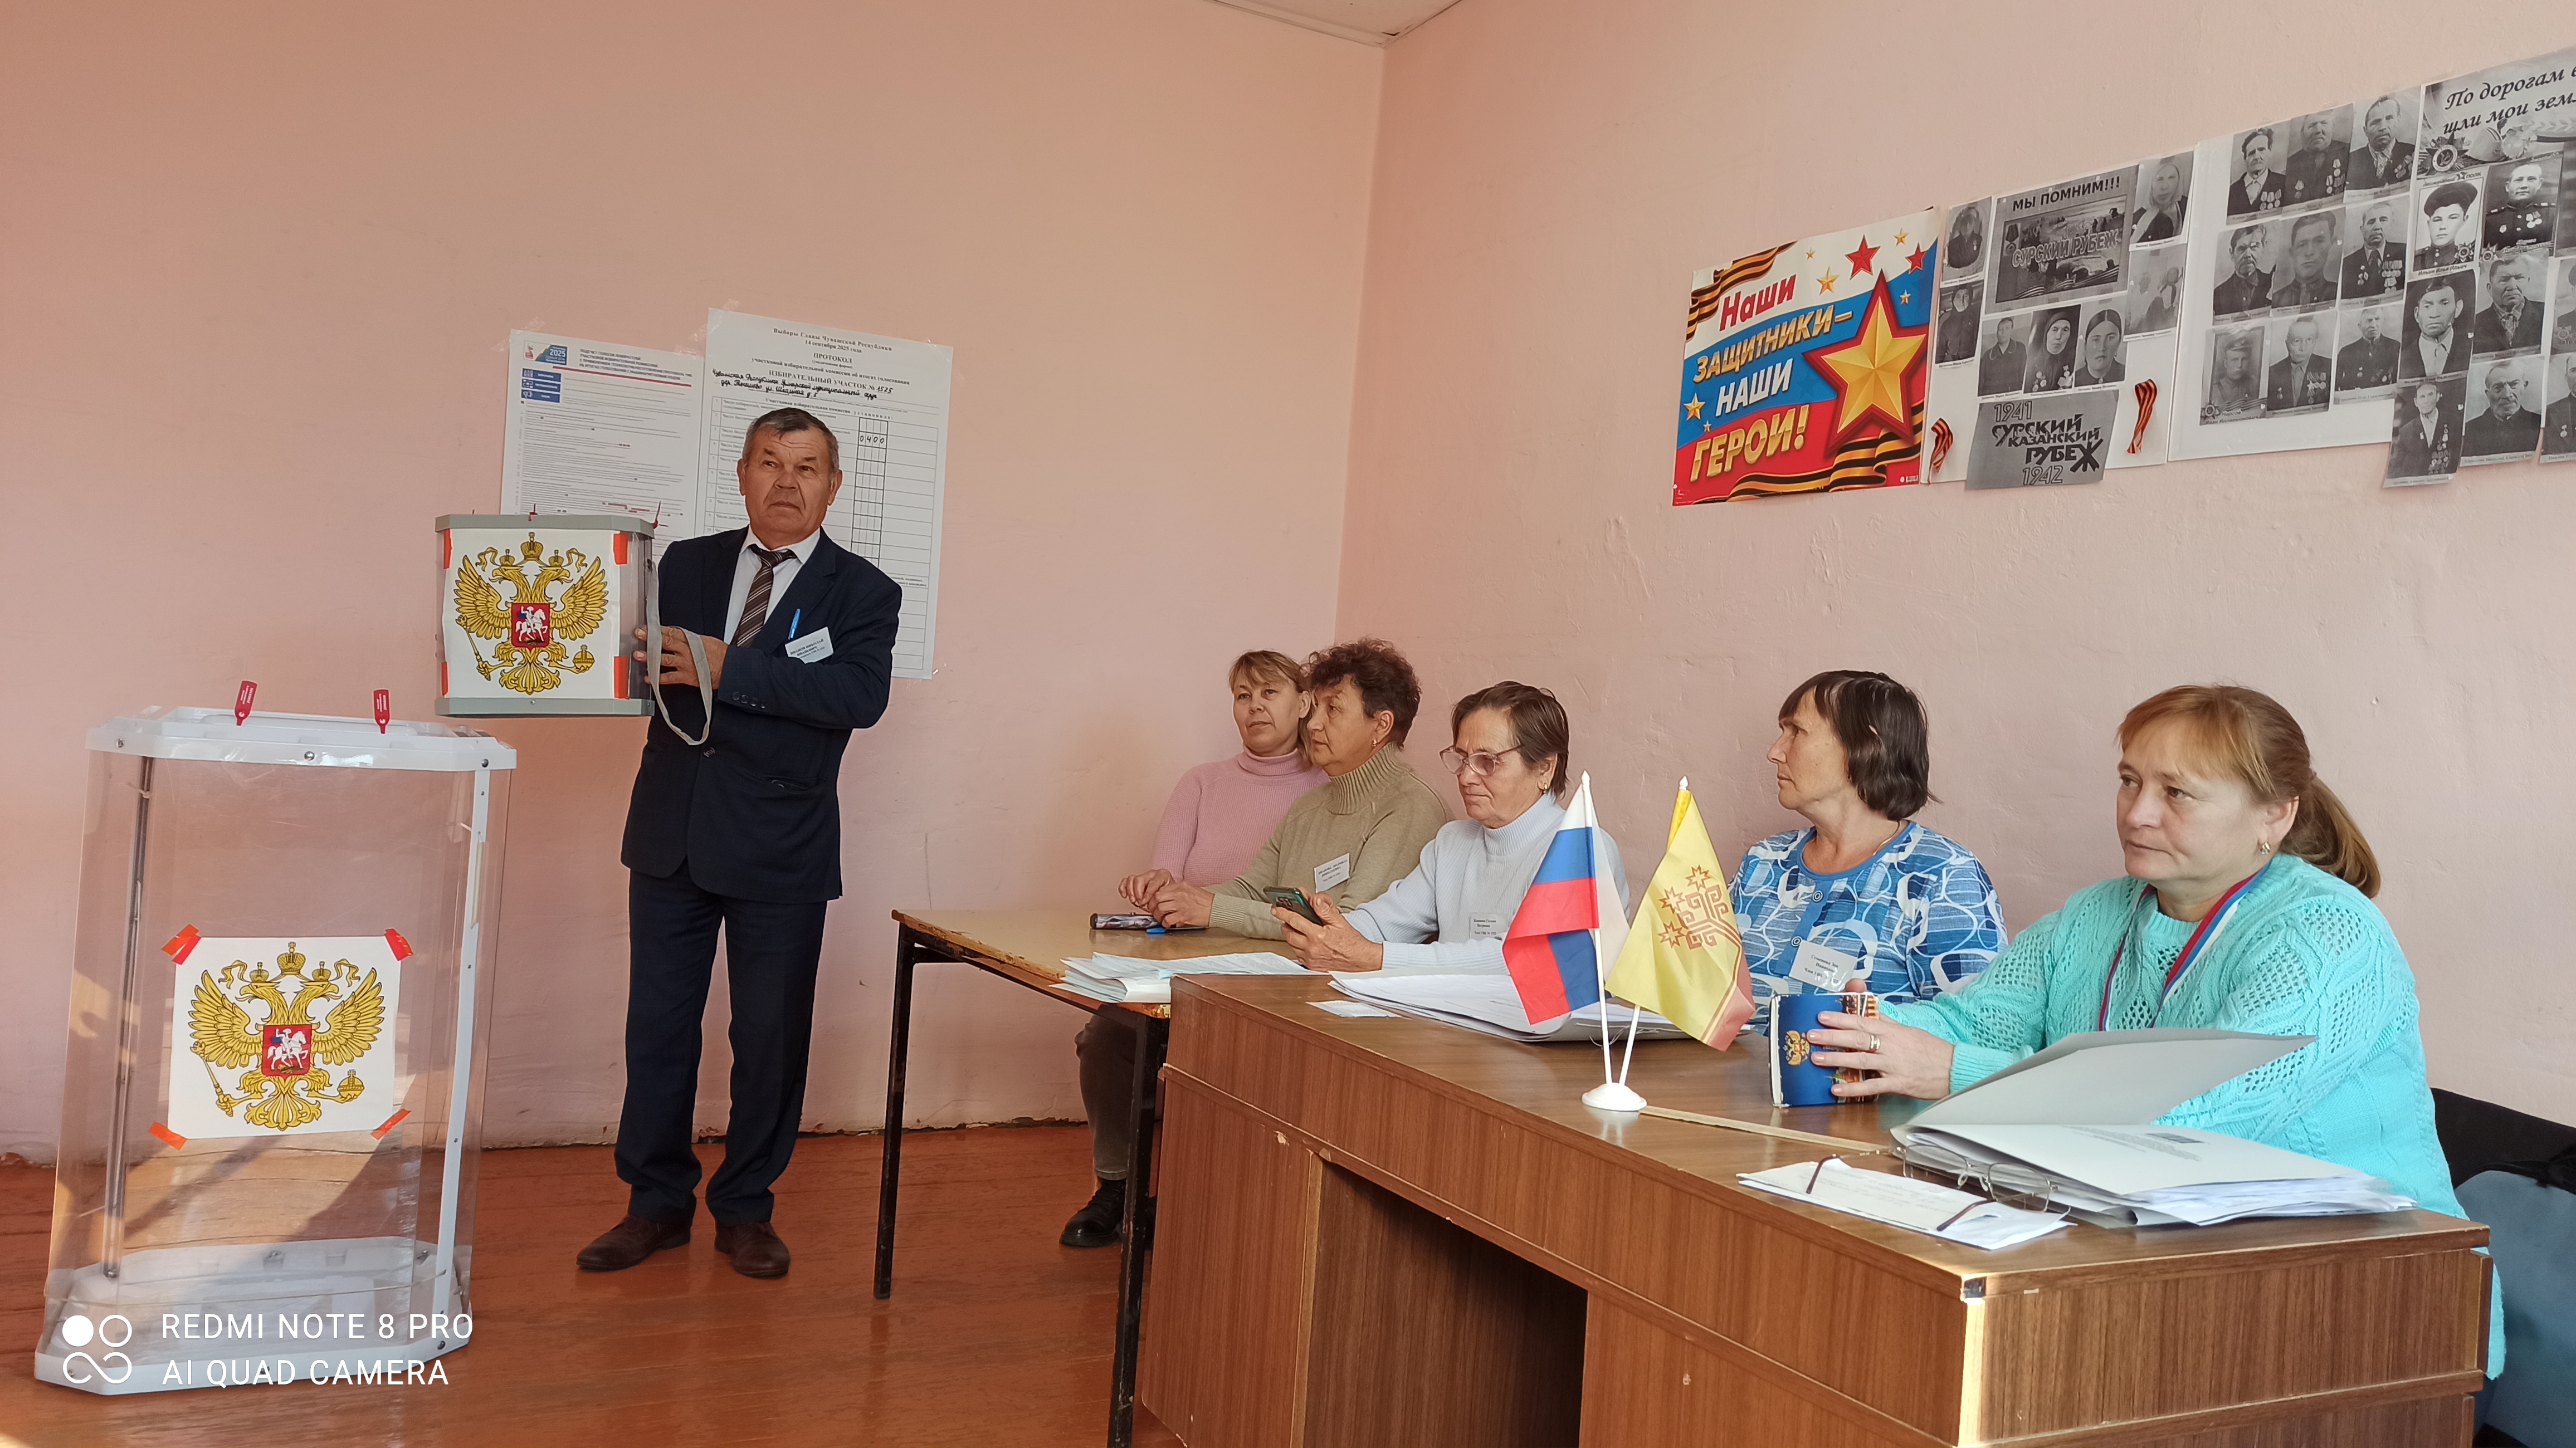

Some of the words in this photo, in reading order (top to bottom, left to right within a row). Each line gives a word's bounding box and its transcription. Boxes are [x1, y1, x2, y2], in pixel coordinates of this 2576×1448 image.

[2445, 87, 2473, 111] По
[2479, 67, 2565, 101] дорогам
[2443, 114, 2482, 135] шли
[2486, 102, 2529, 124] мои
[2013, 194, 2036, 212] МЫ
[2040, 176, 2120, 207] ПОМНИМ!!!
[2012, 239, 2070, 267] СУРСКИЙ
[2072, 228, 2120, 256] РУБЕЖ
[1719, 274, 1797, 332] Наши
[774, 327, 799, 336] Выборы
[801, 332, 821, 340] Главы
[822, 335, 856, 345] Чувашской
[858, 341, 892, 351] Республики
[812, 341, 837, 350] сентября
[549, 349, 566, 358] 2025
[813, 353, 853, 364] ПРОТОКОЛ
[752, 358, 783, 366] участковой
[784, 362, 824, 372] избирательной
[877, 376, 910, 385] голосования
[769, 369, 832, 384] ИЗБИРАТЕЛЬНЫЙ
[834, 379, 868, 390] УЧАСТОК
[876, 385, 894, 394] 1525
[1715, 358, 1793, 417] НАШИ
[1994, 400, 2033, 422] 1941
[1690, 404, 1809, 482] ГЕРОИ!
[1992, 413, 2083, 447] СУРСКИЙ
[2008, 427, 2101, 448] КАЗАНСКИЙ
[2025, 438, 2104, 473] РУБЕЖ
[2022, 464, 2064, 486] 1942
